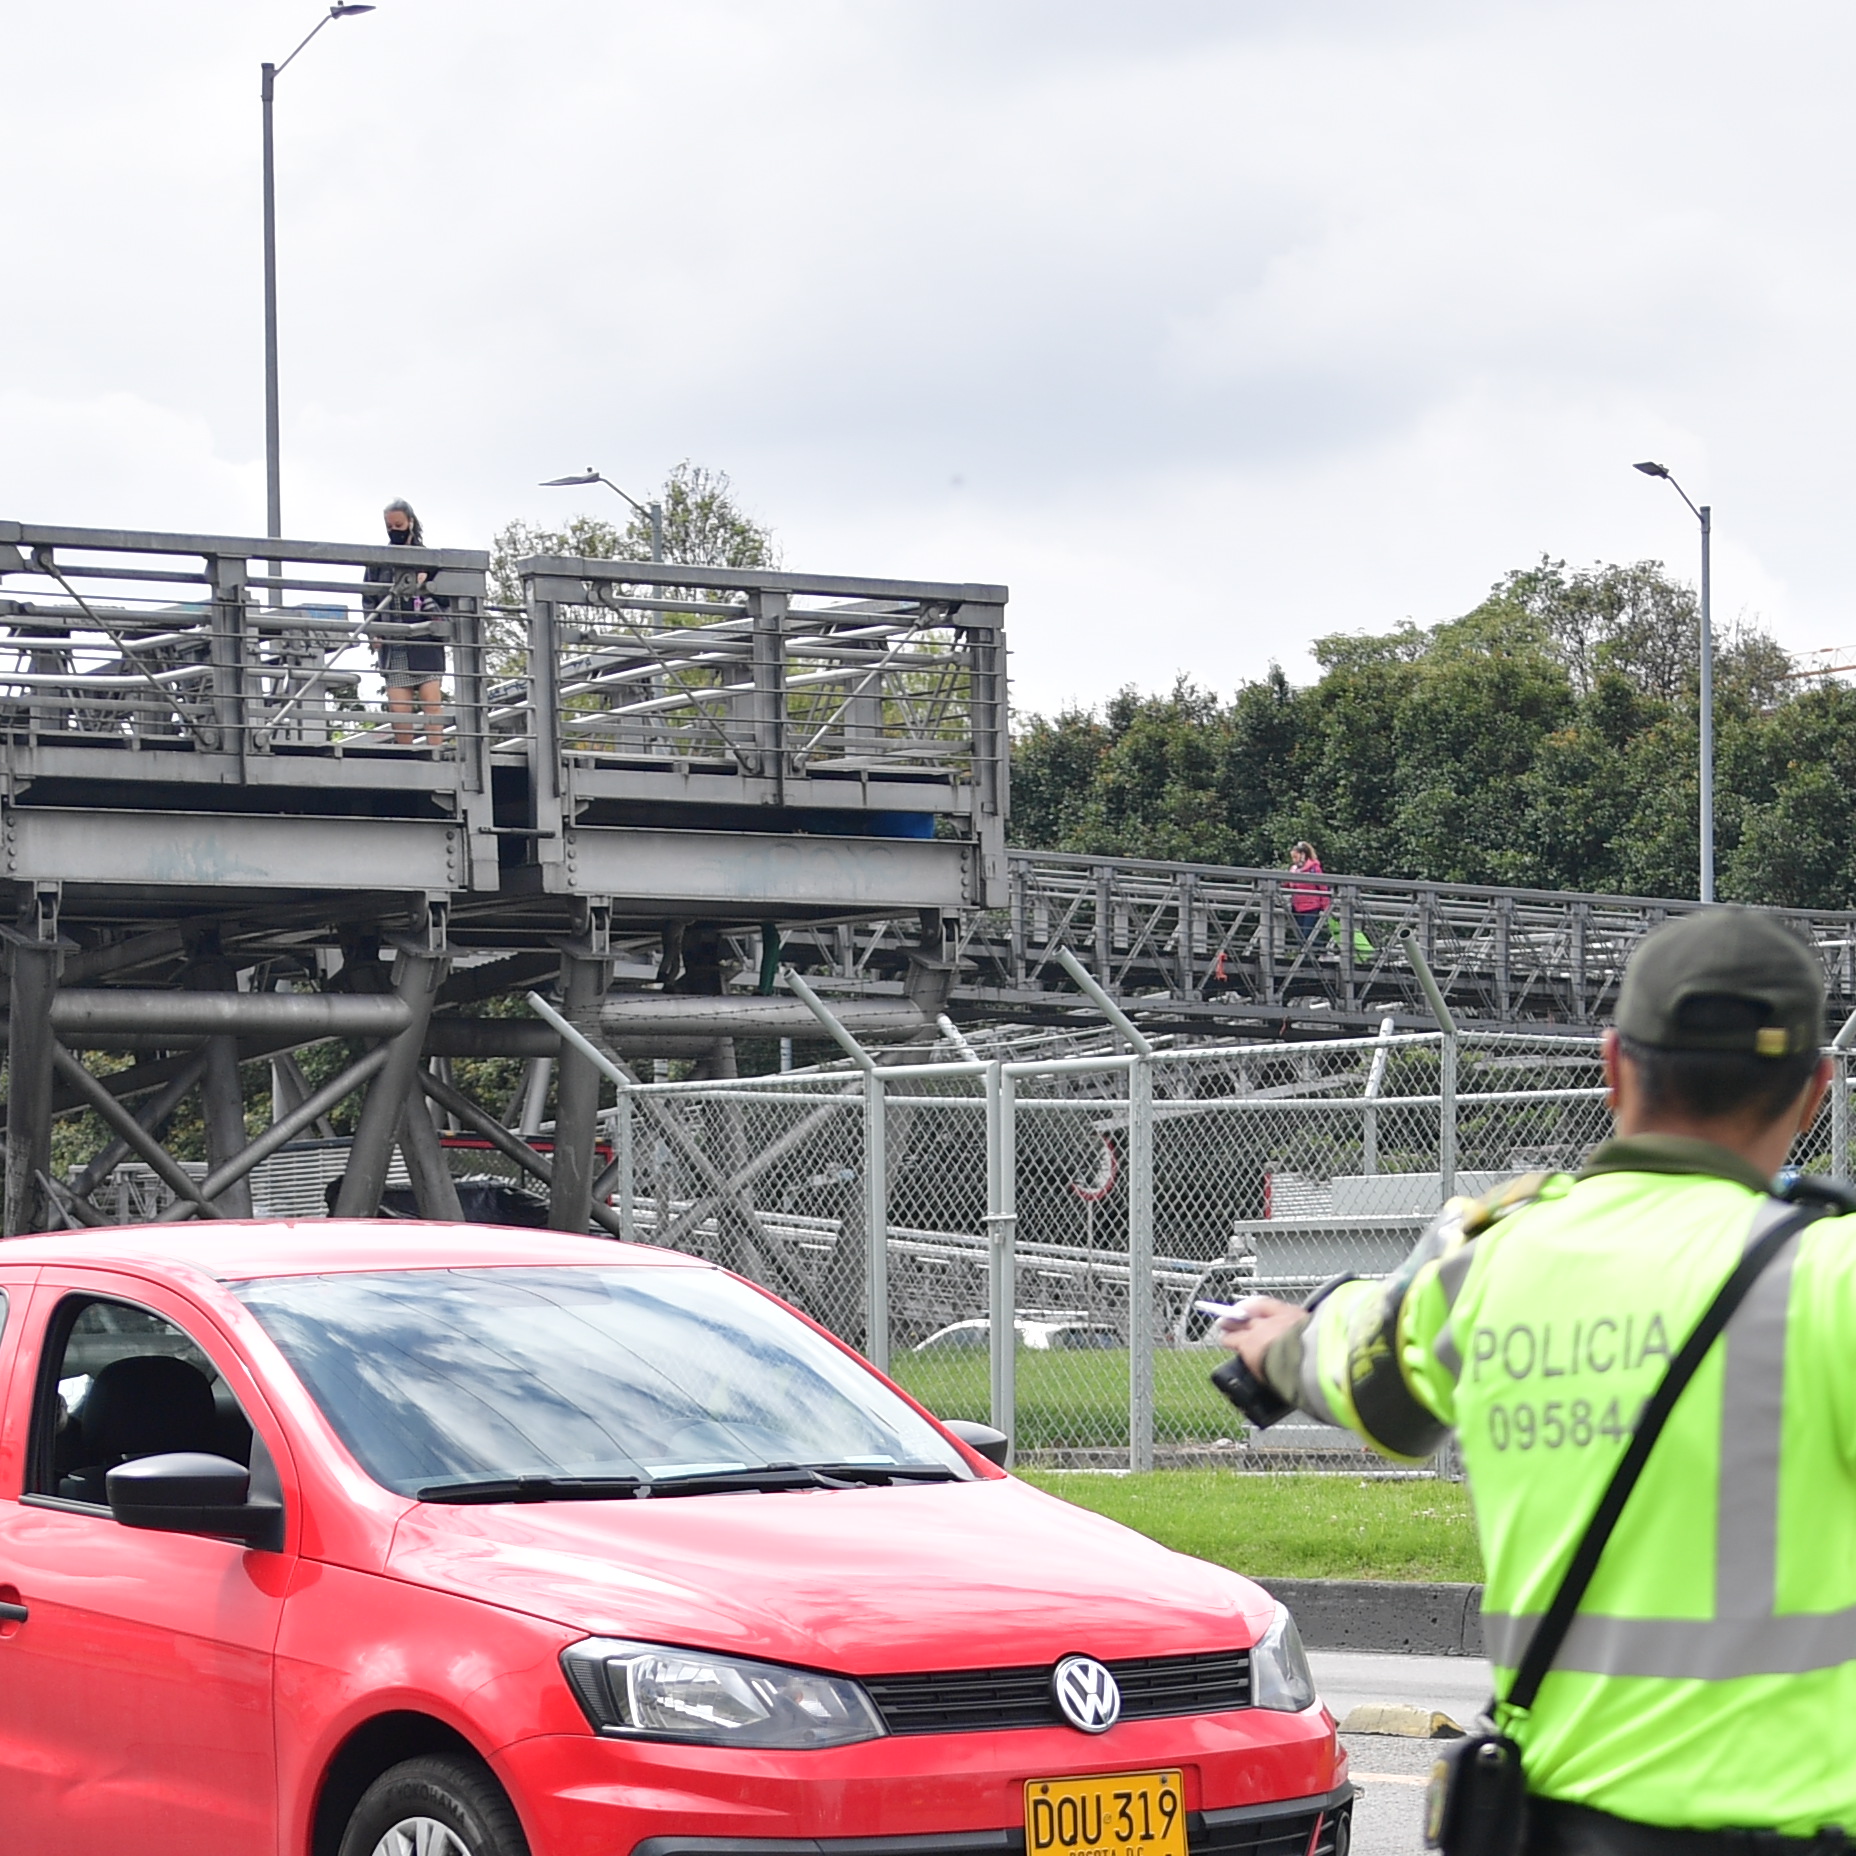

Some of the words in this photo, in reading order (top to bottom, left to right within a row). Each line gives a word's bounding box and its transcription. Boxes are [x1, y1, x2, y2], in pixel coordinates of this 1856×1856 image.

[1473, 1313, 1675, 1382] POLICIA
[1033, 1796, 1102, 1849] DQU
[1113, 1790, 1178, 1842] 319
